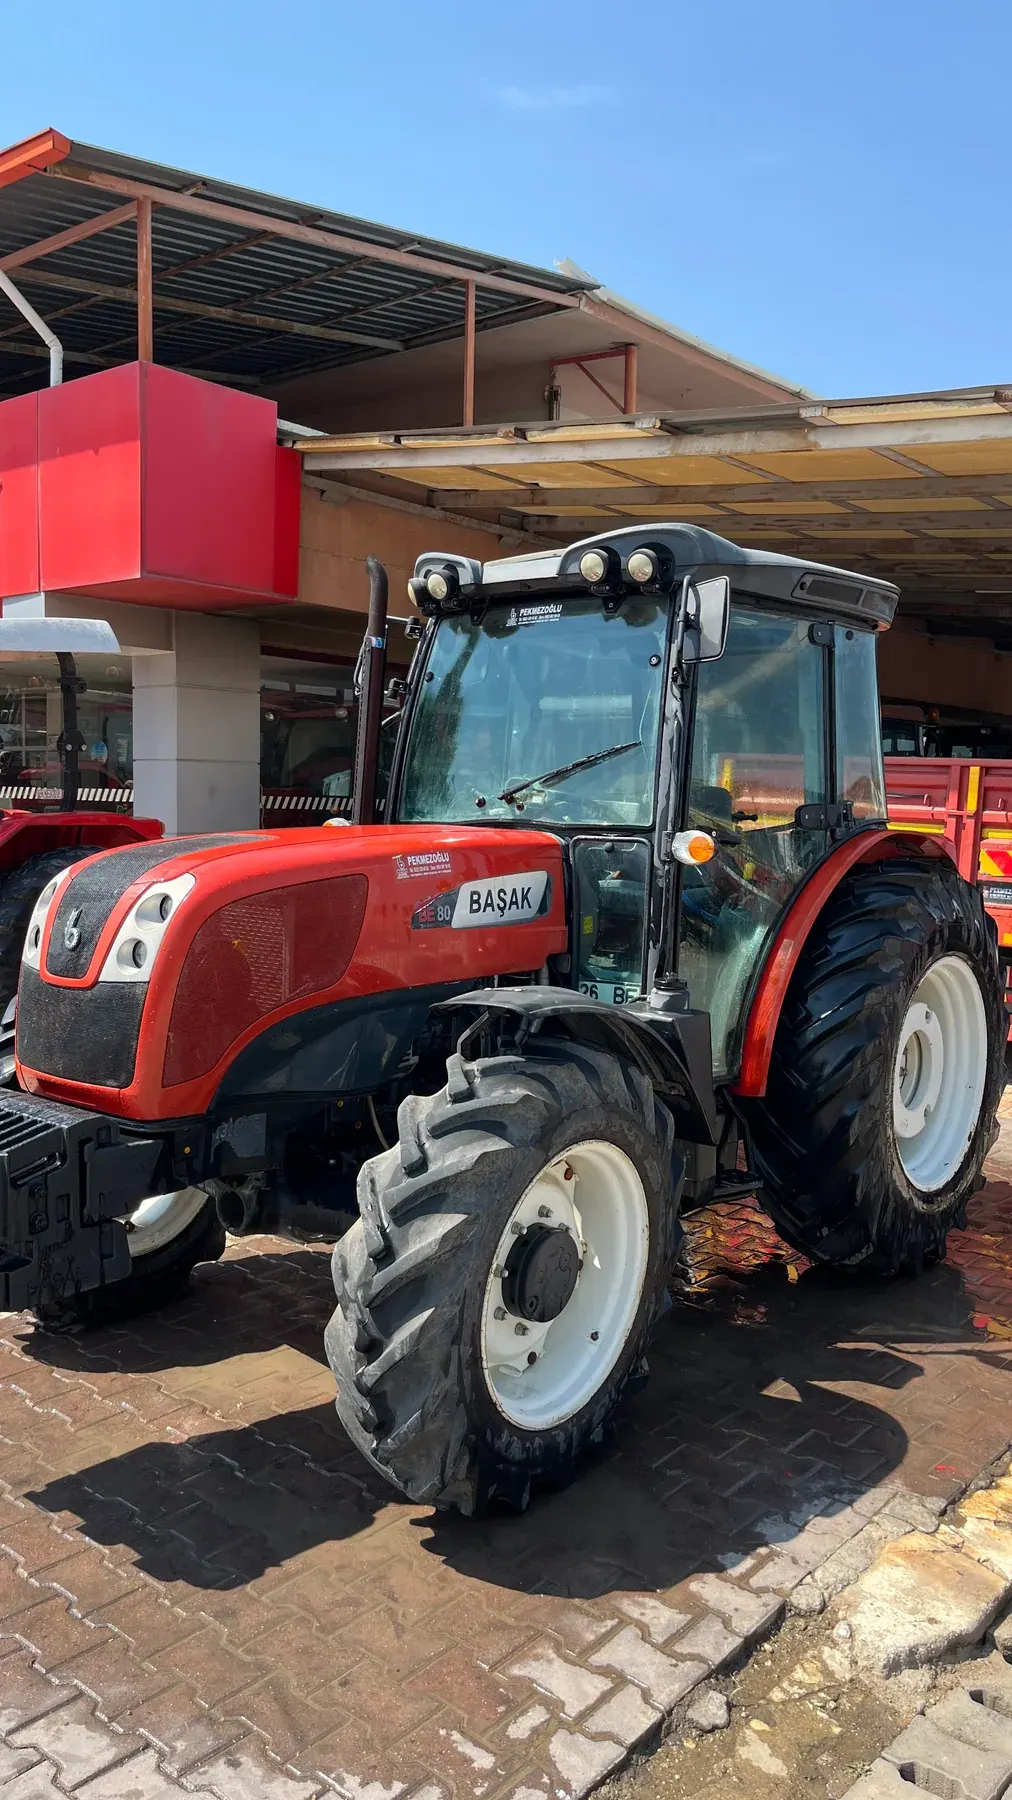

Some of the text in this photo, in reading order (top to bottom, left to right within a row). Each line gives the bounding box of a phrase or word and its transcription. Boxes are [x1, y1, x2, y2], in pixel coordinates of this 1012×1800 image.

[519, 604, 562, 616] PEKMEZOĞLU
[407, 851, 449, 866] PEKMEZOĞLU
[469, 886, 532, 917] BAŞAK
[418, 904, 451, 922] BE 80
